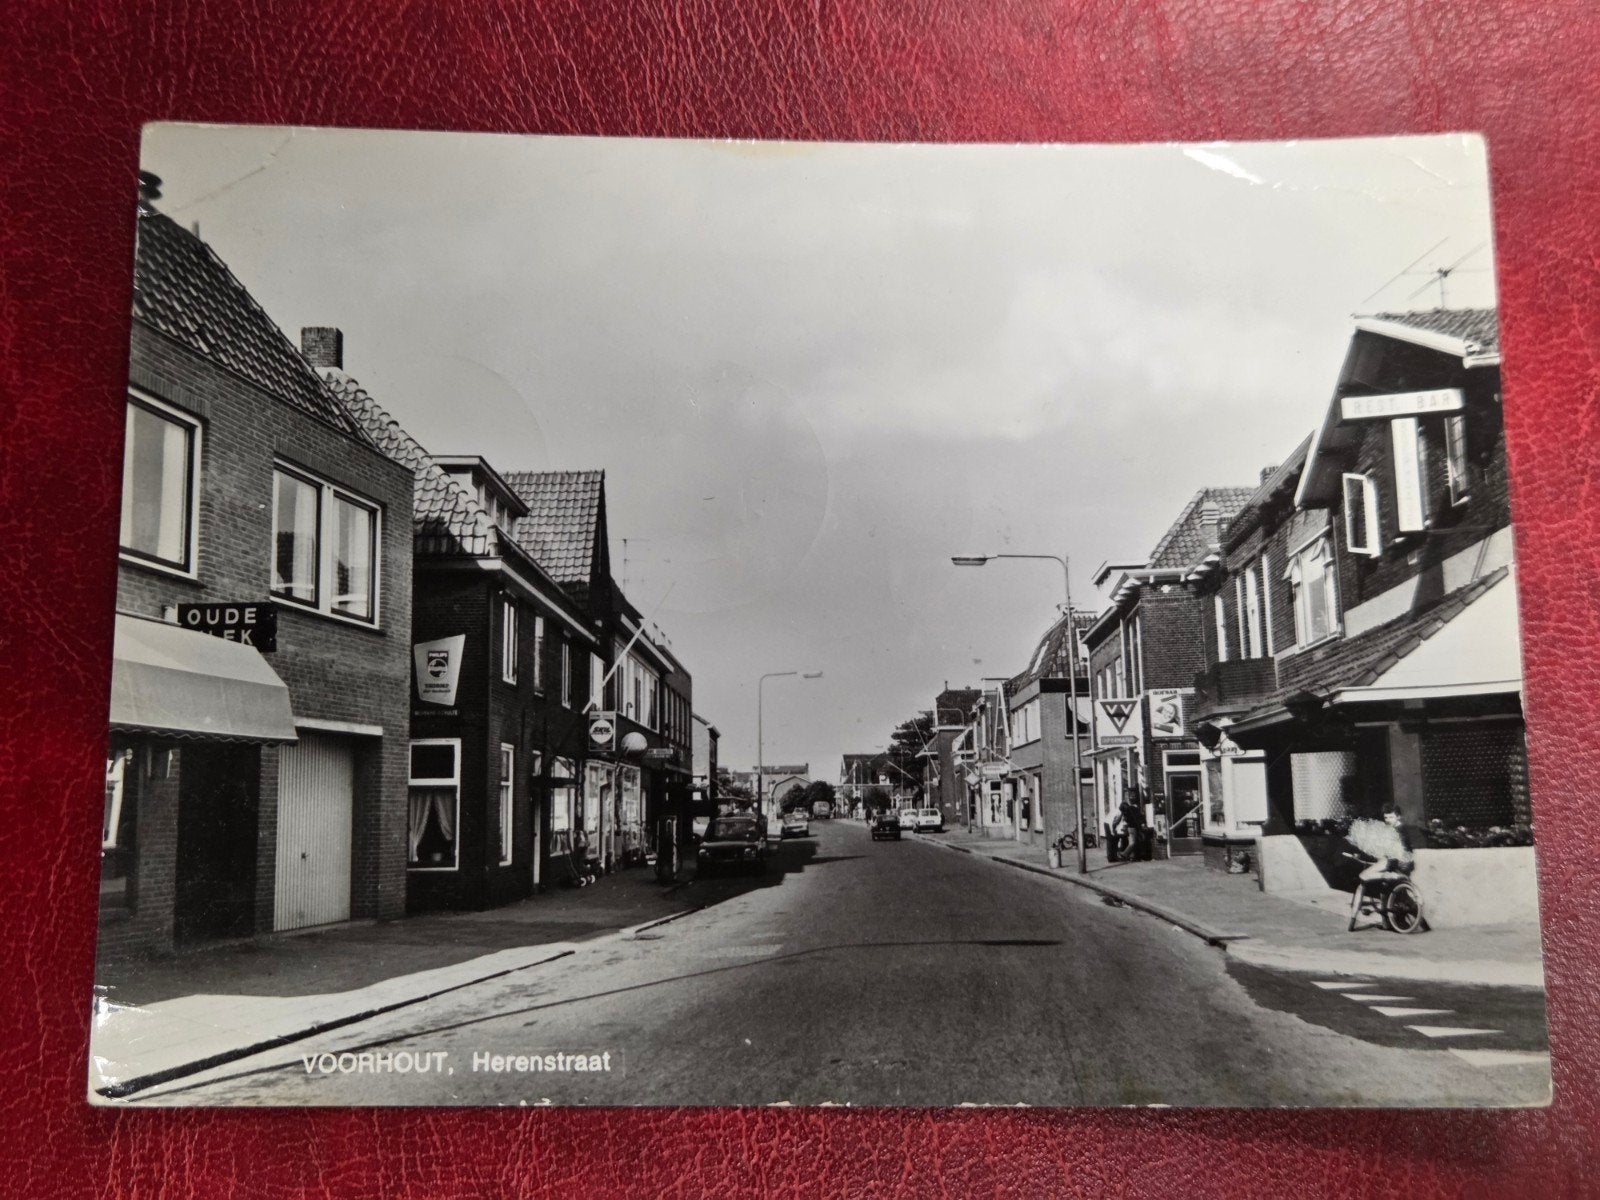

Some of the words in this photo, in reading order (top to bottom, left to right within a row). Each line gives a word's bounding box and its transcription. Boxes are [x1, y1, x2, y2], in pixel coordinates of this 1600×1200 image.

[1416, 393, 1451, 409] BAR
[187, 607, 257, 625] OUDE
[200, 629, 253, 645] EK
